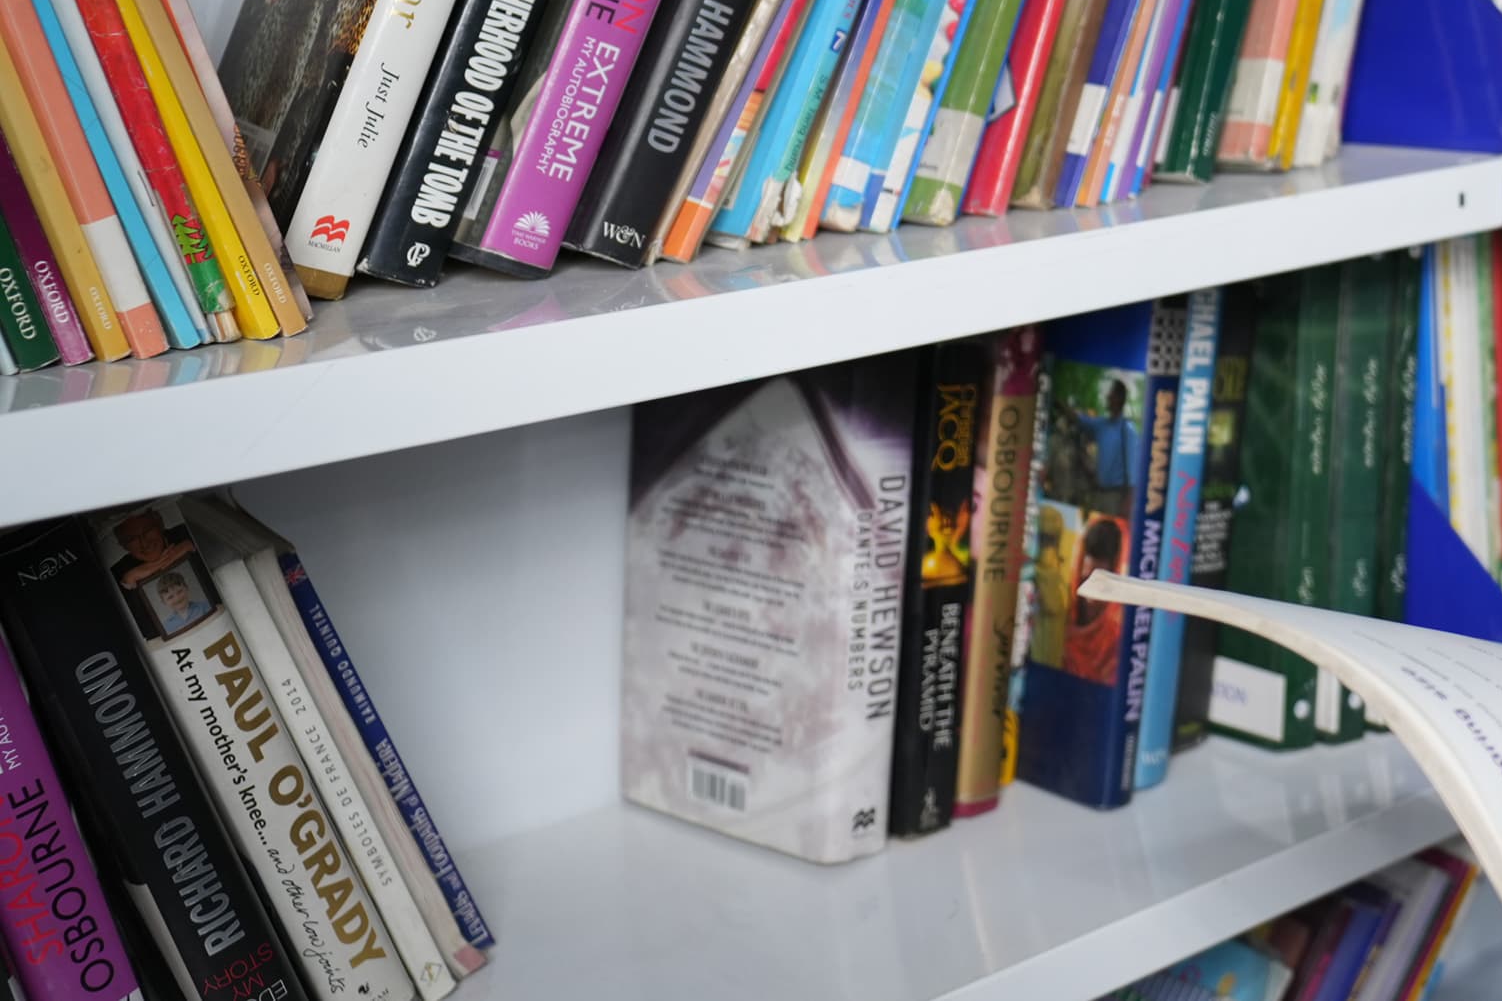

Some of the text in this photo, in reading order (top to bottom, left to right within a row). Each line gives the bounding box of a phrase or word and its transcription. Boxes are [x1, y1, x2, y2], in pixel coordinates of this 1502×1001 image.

[357, 62, 401, 150] Just Julie
[432, 119, 486, 171] THE
[450, 90, 495, 129] OF
[535, 36, 597, 175] MY AUTOBIOGRAPHY
[548, 40, 621, 183] EXTREME
[410, 162, 469, 230] TOMB
[602, 220, 647, 250] W&N
[0, 267, 37, 341] OXFORD
[34, 260, 69, 325] OXFORD
[89, 286, 113, 331] OXFORD
[237, 254, 261, 297] OXFORD
[263, 262, 287, 305] OXFORD
[930, 382, 962, 472] JACQ
[1145, 389, 1176, 514] SAHARA
[1177, 377, 1211, 456] PALIN
[982, 403, 1023, 586] OSBOURNE
[866, 475, 907, 722] DAVID HEWSON
[1133, 518, 1162, 640] MICAEL
[171, 645, 193, 673] At
[308, 602, 376, 724] RAIMUNDO QUINTAL
[847, 600, 868, 693] NUMBERS
[918, 627, 942, 732] PYRAMID
[932, 601, 963, 751] BENEATH THE
[1124, 642, 1149, 722] PALIN
[185, 675, 208, 704] my
[4, 747, 22, 771] MY
[199, 704, 247, 786] mother's
[280, 677, 394, 888] SYMBOLES DE FRANCE 2014
[74, 650, 246, 958] HAMMOND RICHARD
[203, 630, 388, 969] PAUL O'GRADY
[12, 777, 115, 992] OSBOURNE
[266, 846, 295, 875] and
[282, 876, 312, 919] other
[203, 940, 274, 997] STORY
[301, 918, 326, 947] low
[302, 947, 346, 995] joints
